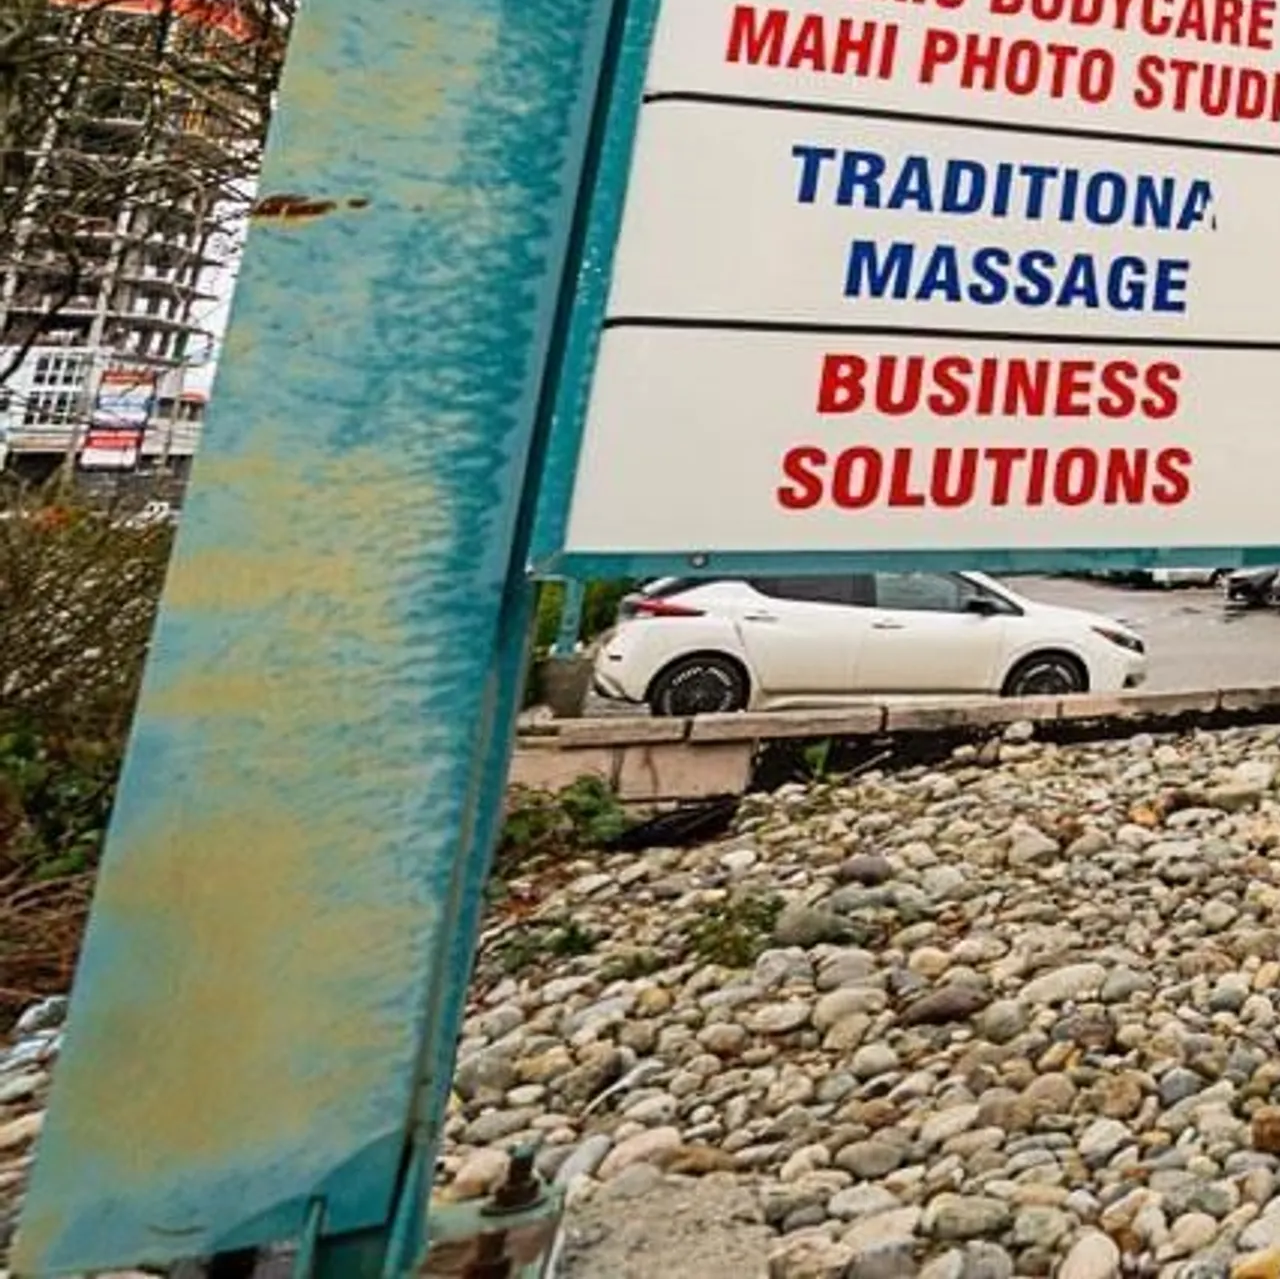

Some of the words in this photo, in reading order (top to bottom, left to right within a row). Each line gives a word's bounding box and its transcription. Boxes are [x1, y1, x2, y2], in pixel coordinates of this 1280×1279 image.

[724, 4, 902, 80] MAHI
[919, 37, 1116, 107] PHOTO
[792, 144, 1217, 232] TRADITIONA
[842, 240, 1191, 314] MASSAGE
[815, 353, 1182, 419] BUSINESS
[775, 445, 1193, 510] SOLUTIONS
